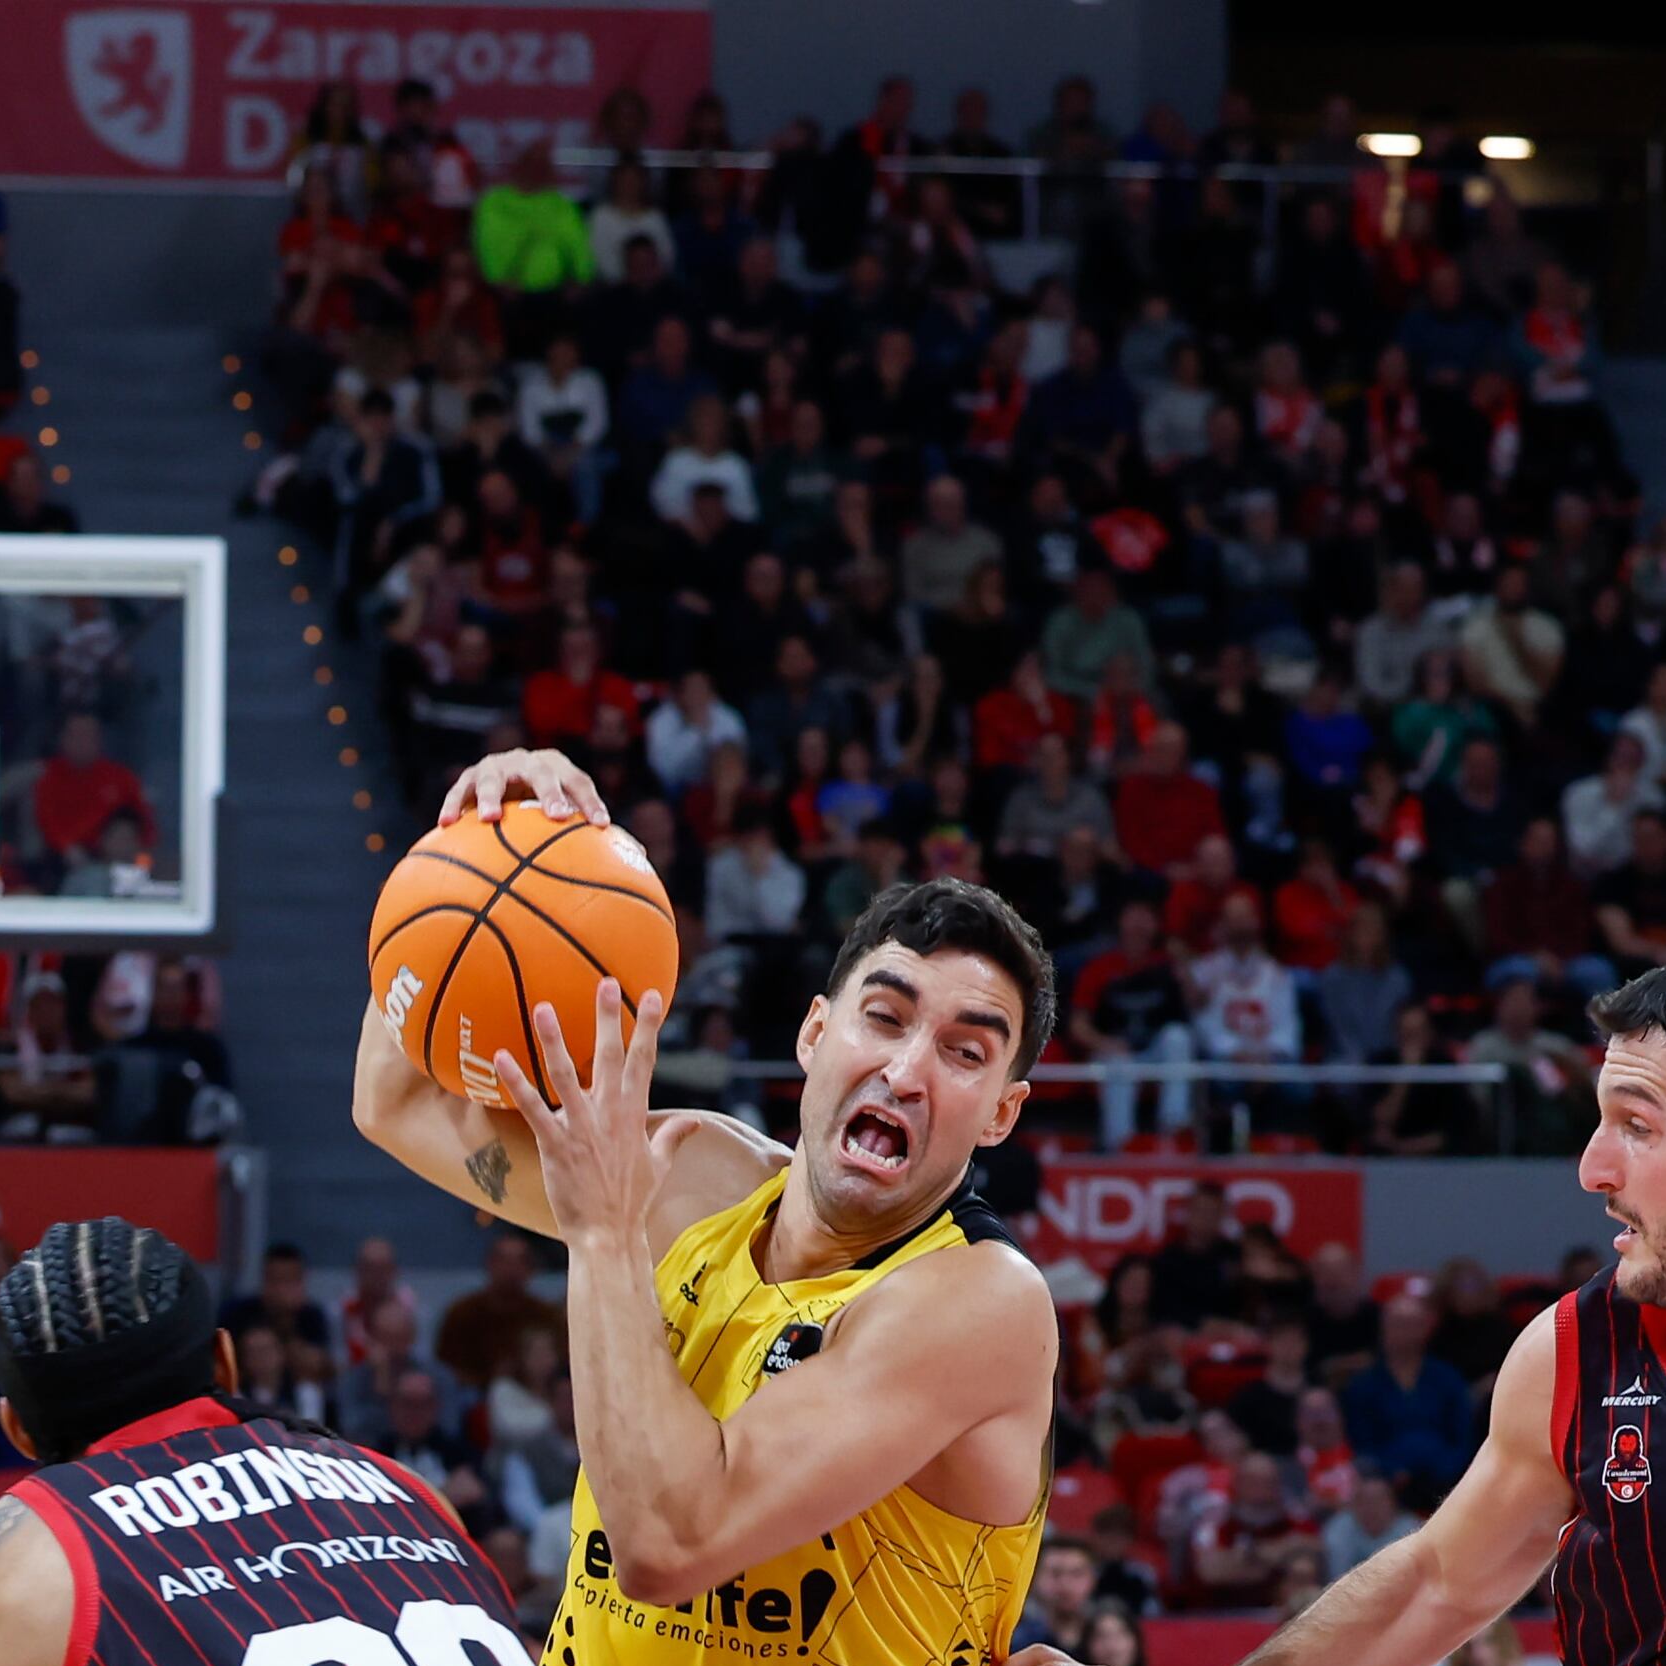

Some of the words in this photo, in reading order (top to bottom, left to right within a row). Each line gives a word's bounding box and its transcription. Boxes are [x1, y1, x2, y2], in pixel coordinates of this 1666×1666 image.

[226, 9, 594, 103] Zaragoza
[1601, 1394, 1662, 1408] MERCURY
[88, 1445, 415, 1537] ROBINSON
[158, 1565, 236, 1602] AIR
[234, 1535, 469, 1583] HORIZONT
[655, 1616, 789, 1660] emociones
